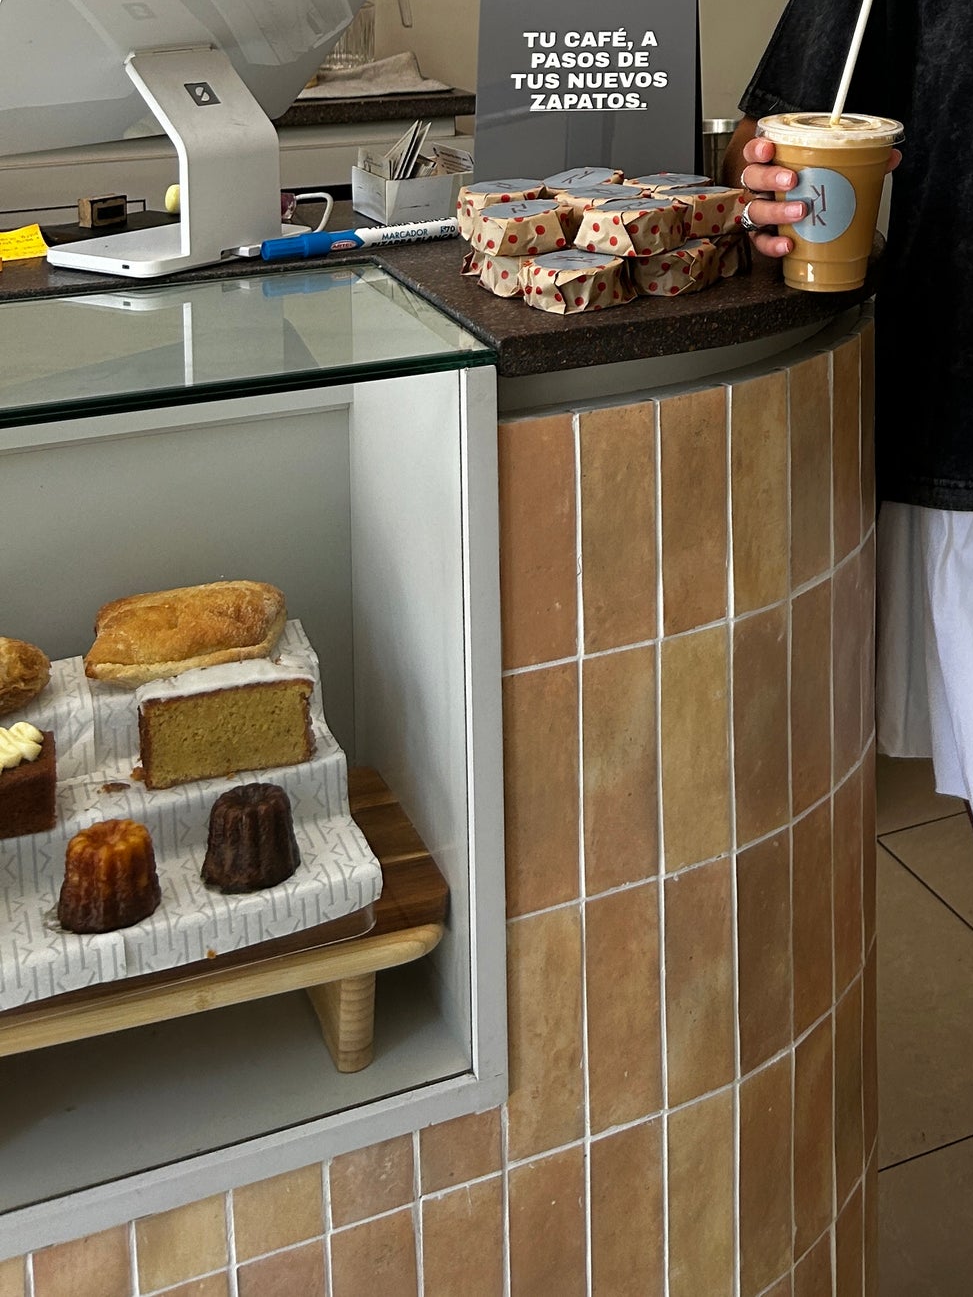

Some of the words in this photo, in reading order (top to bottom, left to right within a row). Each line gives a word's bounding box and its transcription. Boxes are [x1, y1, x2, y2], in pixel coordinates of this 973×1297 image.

[523, 32, 556, 48] TU
[564, 28, 634, 50] CAFÉ,
[641, 31, 658, 47] A
[531, 52, 610, 69] PASOS
[618, 52, 650, 67] DE
[510, 73, 561, 89] TUS
[568, 72, 668, 89] NUEVOS
[530, 93, 648, 110] ZAPATOS.
[381, 228, 429, 241] MARCADOR
